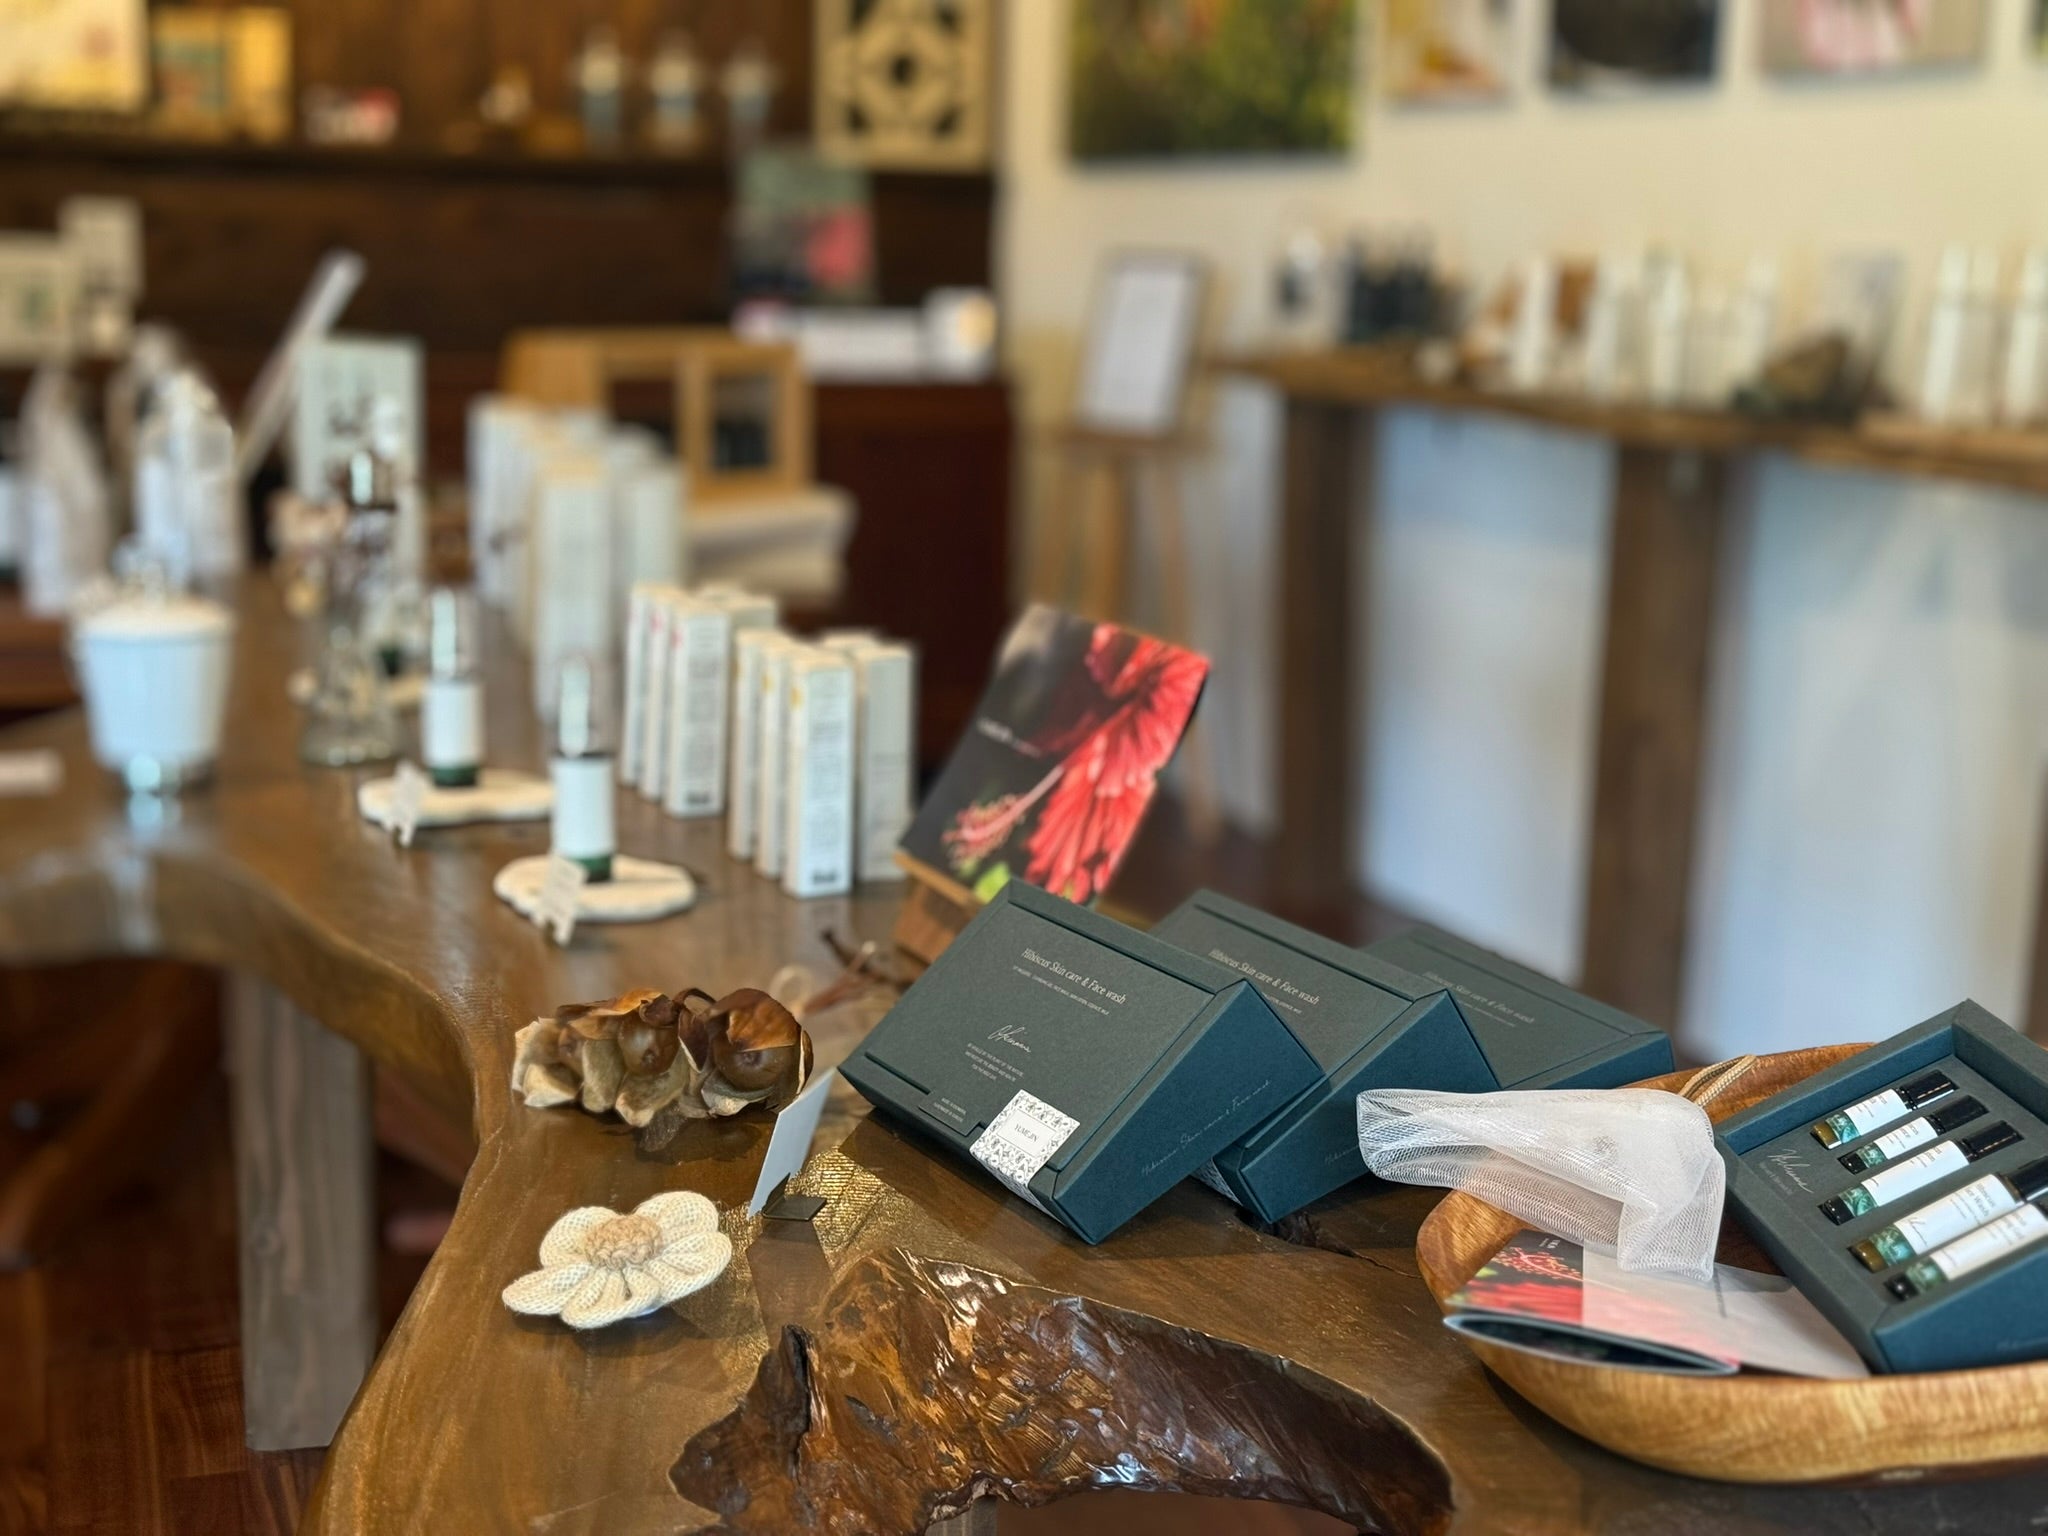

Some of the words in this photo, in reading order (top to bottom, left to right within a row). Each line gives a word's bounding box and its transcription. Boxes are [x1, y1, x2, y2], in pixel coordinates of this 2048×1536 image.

[1021, 947, 1050, 969] Hibiscus
[1049, 961, 1066, 976] Skin
[1065, 971, 1082, 984] care
[1081, 977, 1090, 987] &
[1088, 980, 1106, 996] Face
[1105, 990, 1127, 1005] wash
[1238, 962, 1256, 976] Skin
[1255, 971, 1274, 984] care
[1271, 978, 1281, 988] &
[1279, 981, 1299, 995] Face
[1298, 991, 1320, 1005] wash
